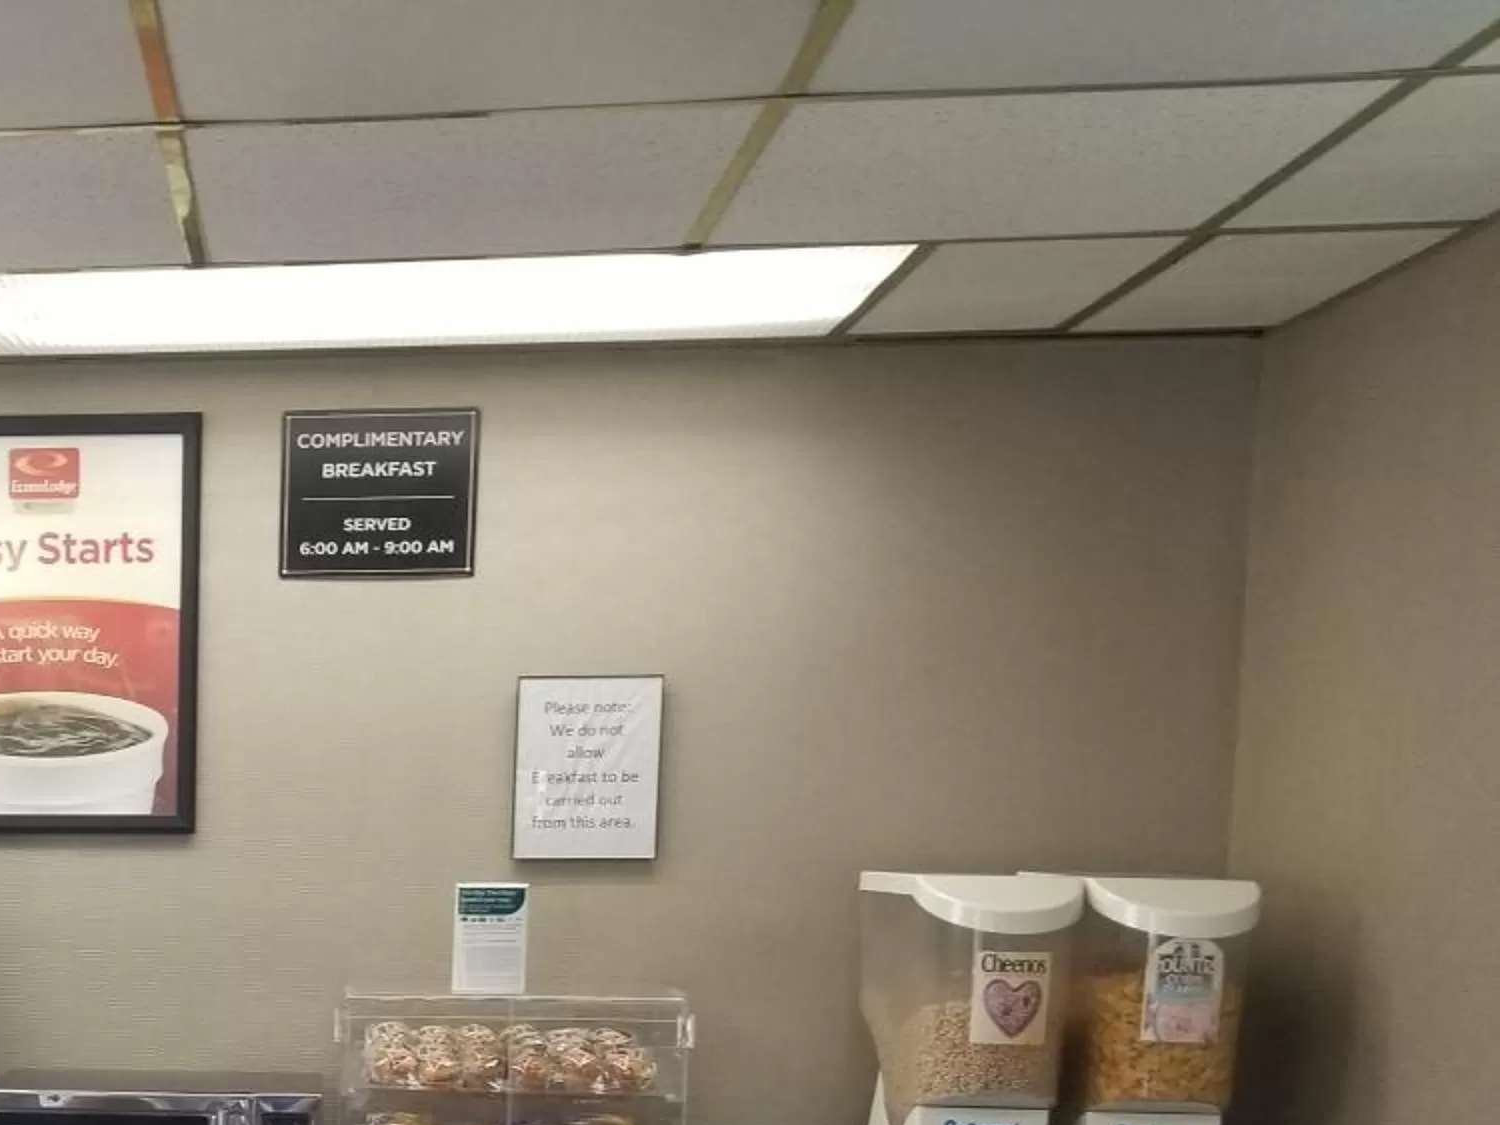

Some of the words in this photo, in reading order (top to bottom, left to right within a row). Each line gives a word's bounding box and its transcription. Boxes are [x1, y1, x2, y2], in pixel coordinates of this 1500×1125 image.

[297, 431, 465, 449] COMPLIMENTARY
[321, 461, 437, 478] BREAKFAST
[343, 517, 412, 531] SERVED
[37, 531, 155, 565] Starts
[299, 541, 338, 556] 6:00
[341, 541, 369, 555] AM
[384, 540, 423, 555] 9:00
[427, 540, 455, 554] AM
[8, 621, 57, 643] quick
[63, 624, 100, 643] way
[37, 649, 78, 666] your
[544, 701, 591, 715] Please
[549, 723, 575, 737] We
[577, 723, 596, 737] do
[599, 723, 624, 737] not
[566, 745, 606, 759] allow
[601, 771, 617, 784] to
[621, 770, 640, 783] be
[598, 794, 624, 806] out
[531, 815, 567, 829] from
[569, 815, 596, 829] this
